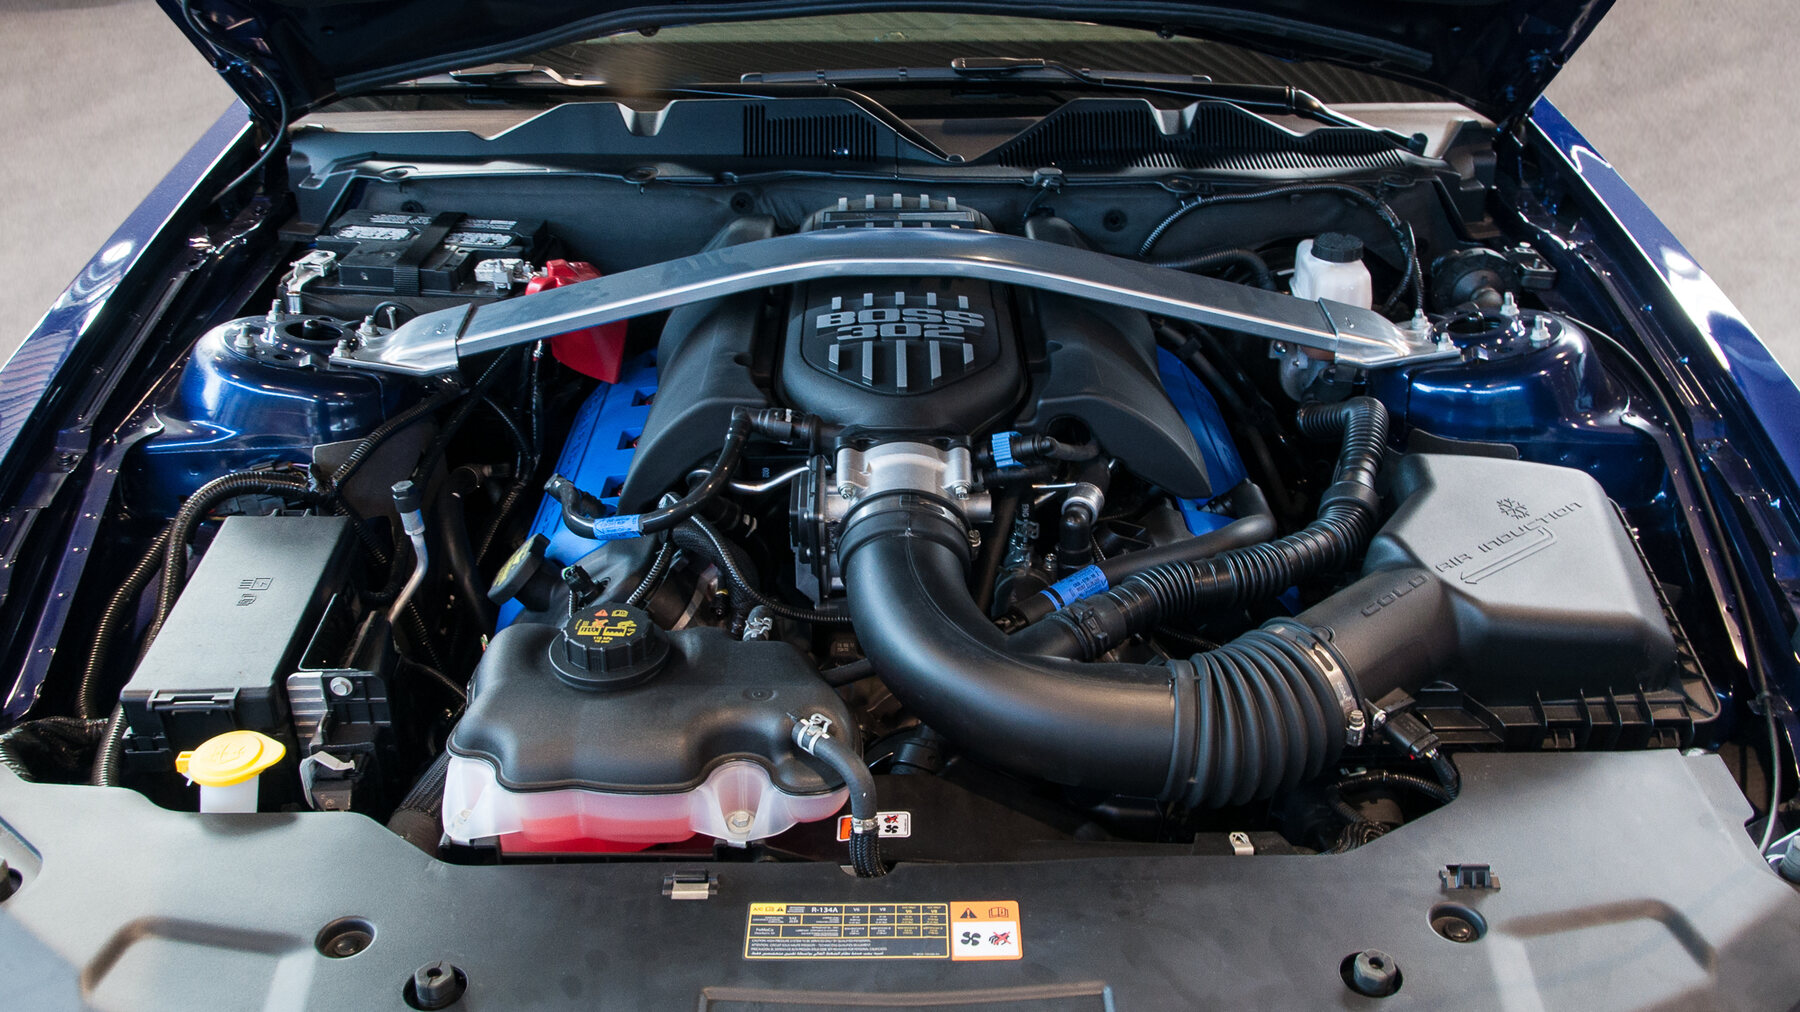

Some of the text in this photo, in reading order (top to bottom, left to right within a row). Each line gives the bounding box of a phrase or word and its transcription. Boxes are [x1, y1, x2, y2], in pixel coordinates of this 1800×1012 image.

[816, 308, 985, 328] BOSS
[836, 323, 966, 341] 302
[1435, 502, 1583, 573] AIR INDUCTION
[1360, 574, 1428, 617] COLD
[811, 906, 839, 914] R-134A
